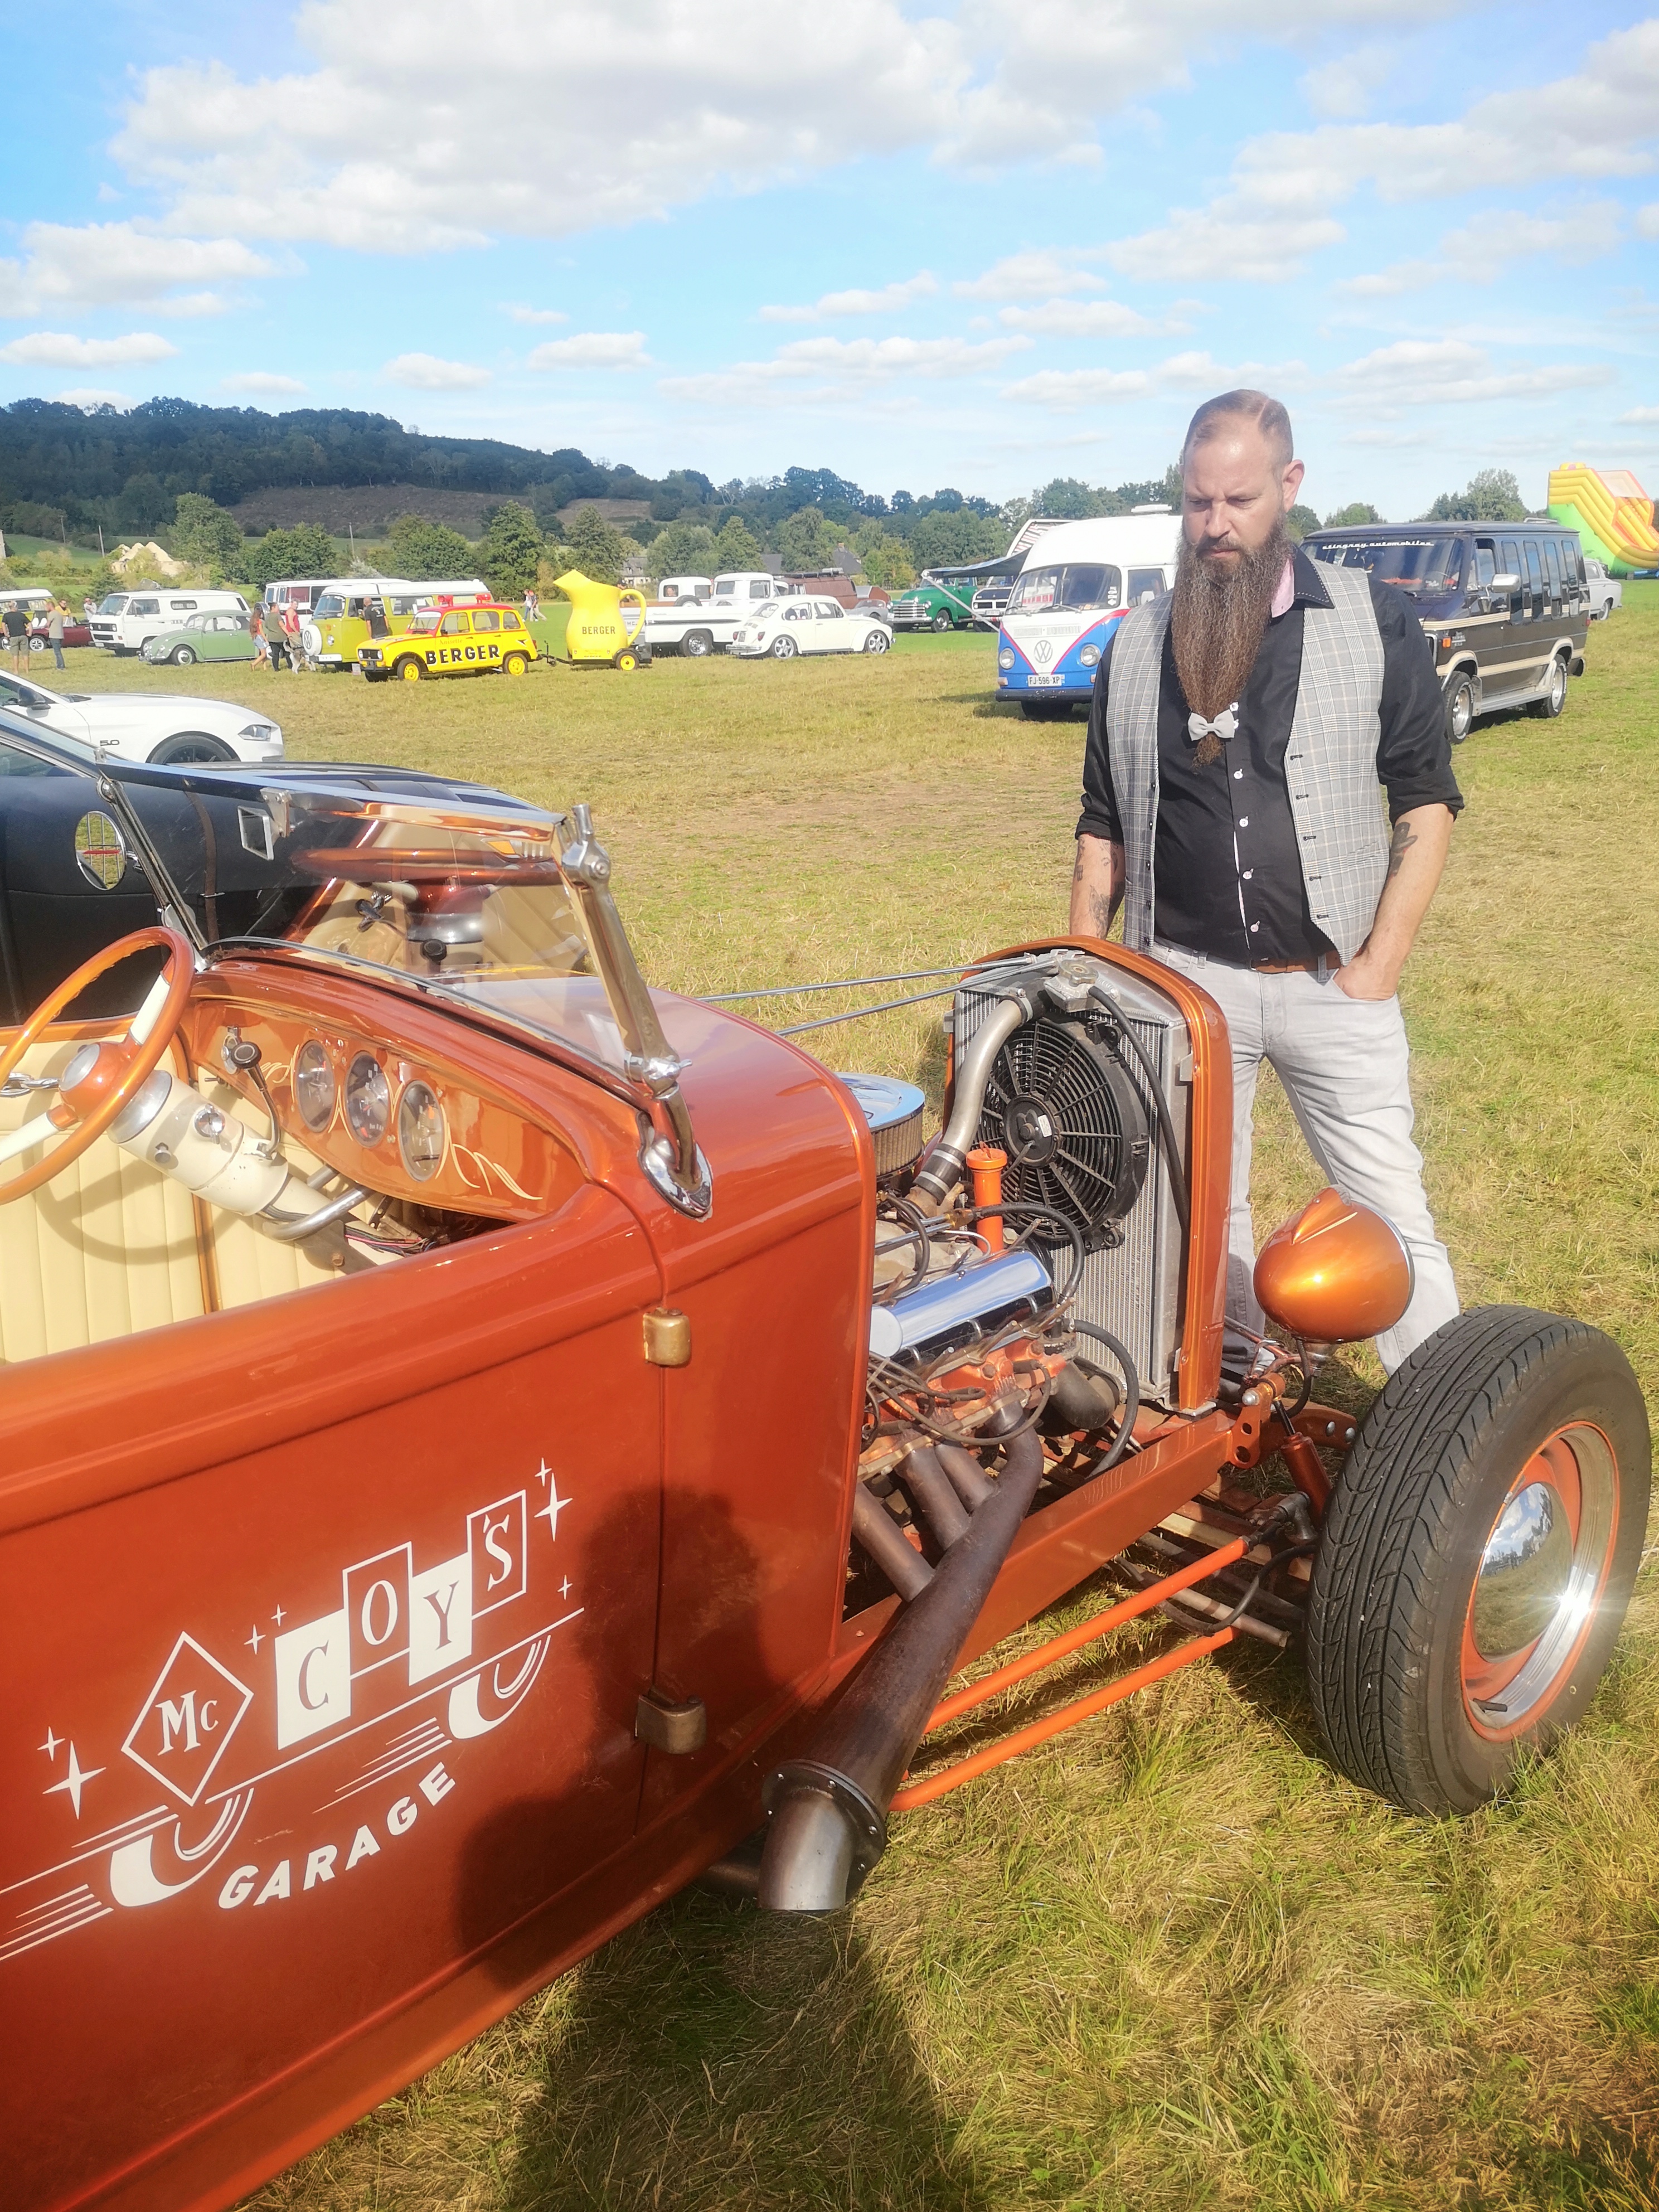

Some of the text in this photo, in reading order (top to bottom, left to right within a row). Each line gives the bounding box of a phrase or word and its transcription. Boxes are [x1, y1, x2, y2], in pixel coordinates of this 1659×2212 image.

[304, 630, 312, 649] VW
[582, 626, 616, 634] BERGER
[425, 644, 500, 664] BERGER
[1034, 640, 1053, 663] VW
[1029, 676, 1060, 685] FJ-596-XP
[298, 1513, 511, 1711] COY'S
[218, 1762, 455, 1910] GARAGE
